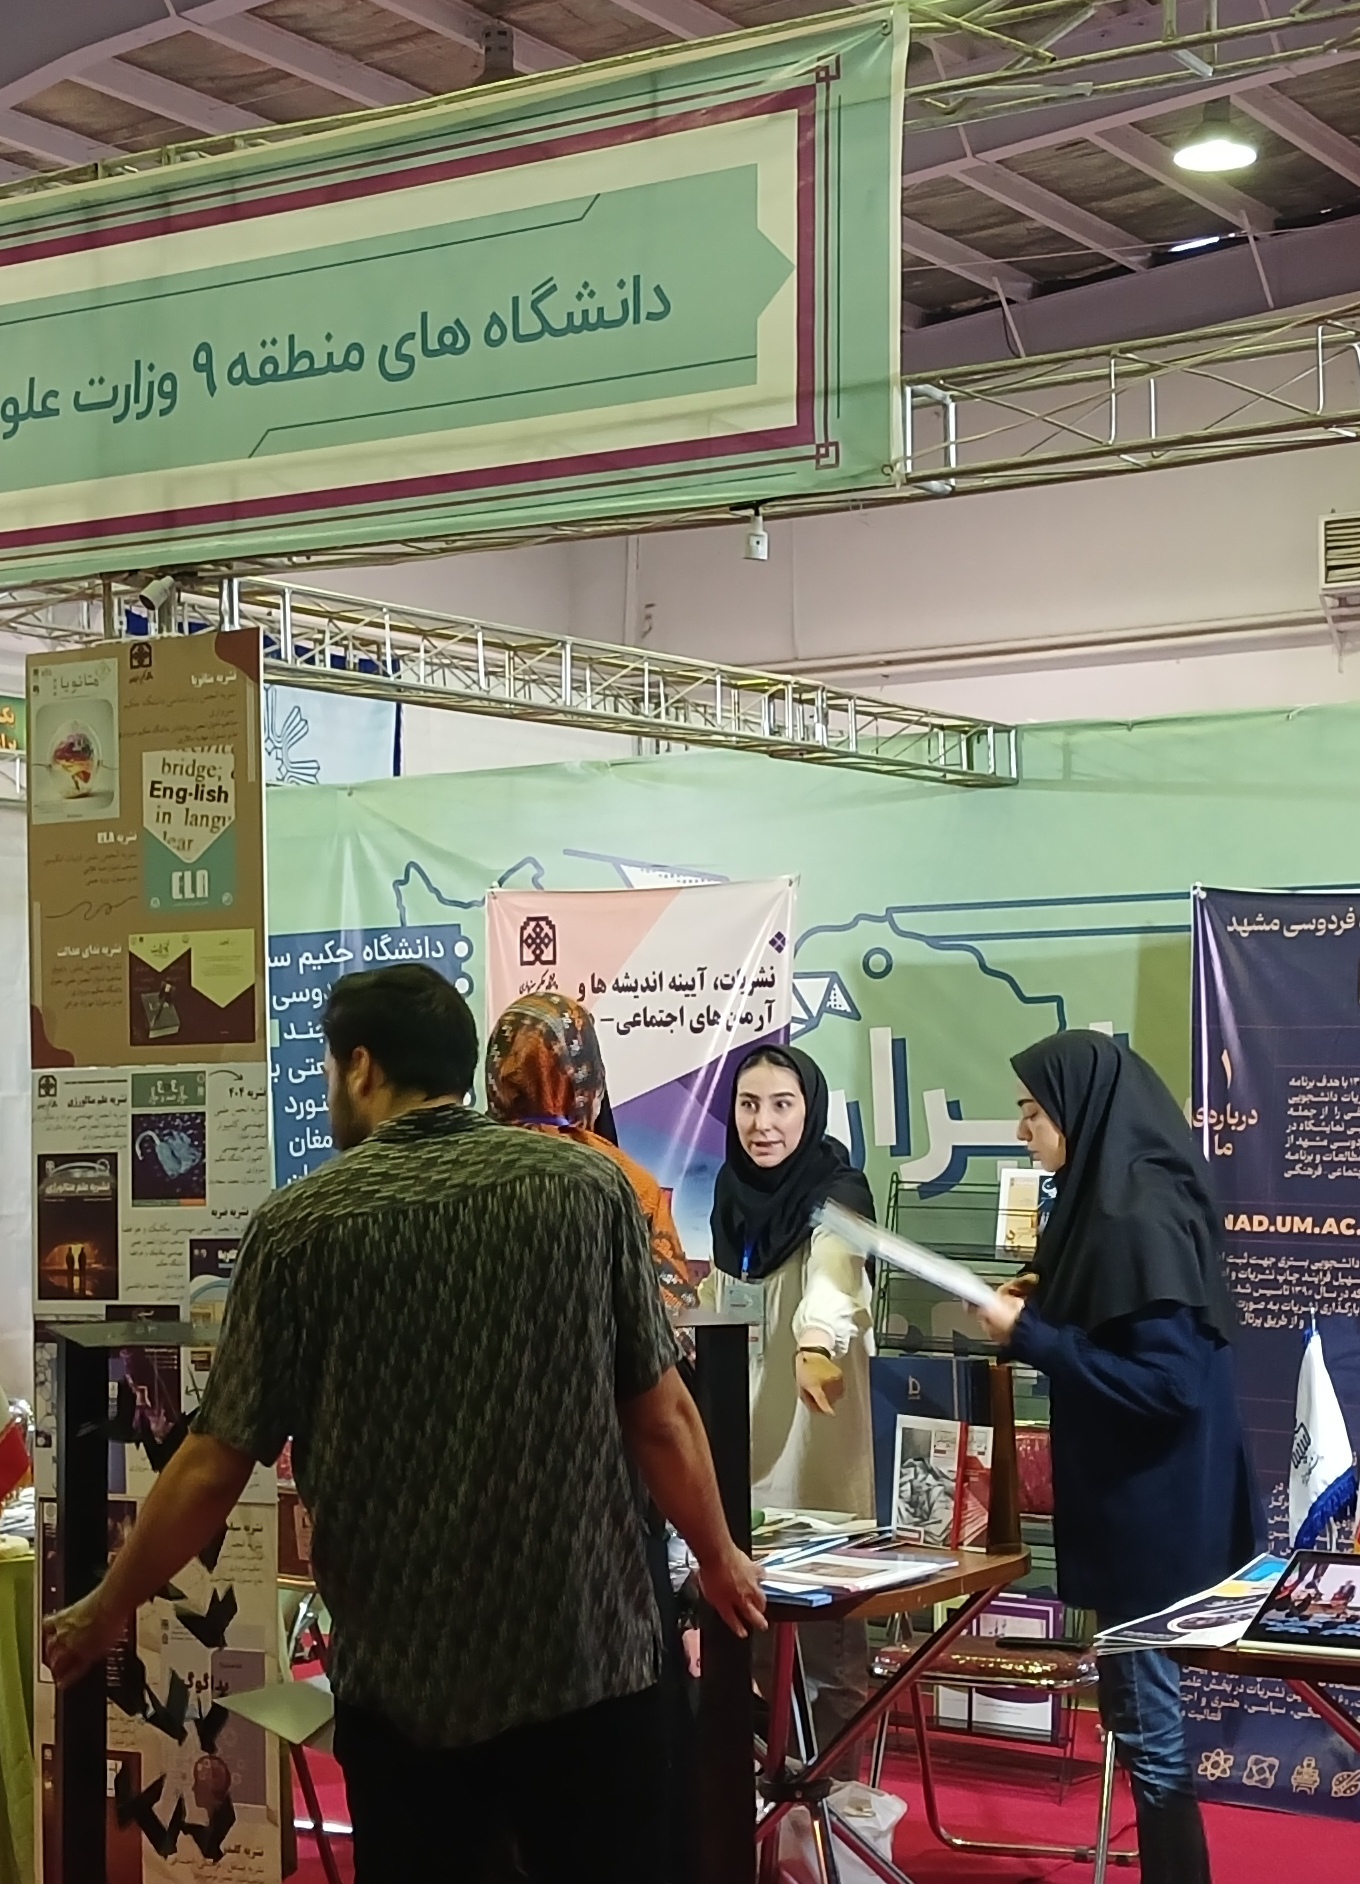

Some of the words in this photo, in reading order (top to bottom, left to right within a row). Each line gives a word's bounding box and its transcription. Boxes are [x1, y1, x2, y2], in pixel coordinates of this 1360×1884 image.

[483, 275, 672, 348] دانشگاه
[378, 311, 471, 382] های
[192, 341, 218, 397] ۹
[227, 331, 365, 386] منطقه
[72, 358, 178, 423] وزارت
[161, 757, 222, 782] bridge;
[156, 805, 172, 824] in
[1226, 911, 1280, 938] مشهد
[1283, 907, 1356, 938] فردوسی
[299, 941, 354, 974] حکیم
[362, 934, 445, 962] دانشگاه
[577, 982, 586, 1002] و
[590, 972, 607, 994] ها
[612, 969, 665, 1001] اندیشه
[668, 966, 708, 998] آیینه
[714, 966, 776, 996] نشریات،
[690, 1004, 721, 1034] های
[1289, 1076, 1315, 1089] برنامه
[1316, 1075, 1340, 1087] هدف
[1288, 1090, 1338, 1104] دانشجویی
[1287, 1105, 1317, 1118] جمله
[1299, 1120, 1345, 1134] نمایشگاه
[1214, 1132, 1233, 1158] ما
[1296, 1136, 1328, 1149] مشهد
[1285, 1150, 1313, 1164] برنامه
[1226, 1252, 1248, 1265] ثبت
[1249, 1256, 1276, 1267] جهت
[1310, 1257, 1360, 1271] دانشجویی
[1238, 1268, 1275, 1281] نشریات
[1277, 1270, 1300, 1284] چاپ
